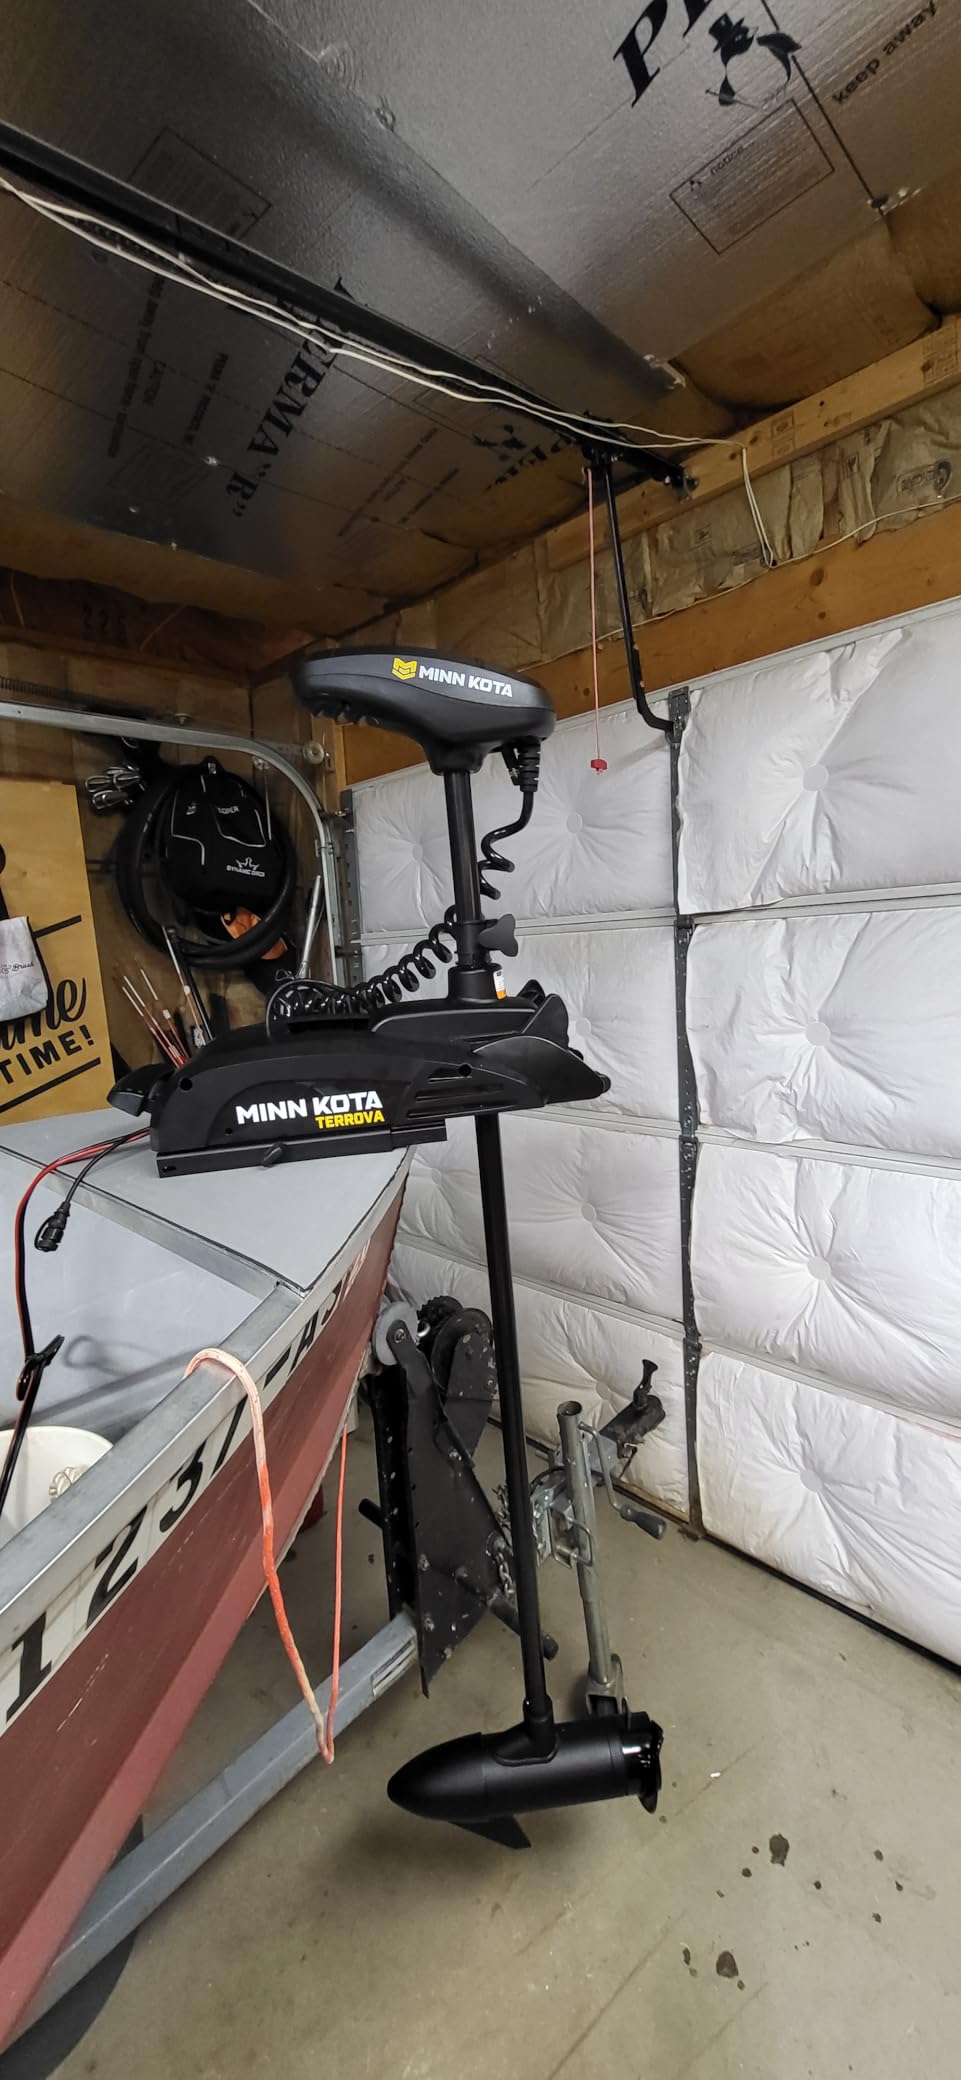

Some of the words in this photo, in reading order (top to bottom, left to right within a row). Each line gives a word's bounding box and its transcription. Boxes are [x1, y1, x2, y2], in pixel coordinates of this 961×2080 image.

[613, 0, 712, 107] P
[832, 58, 880, 105] keep
[883, 1, 937, 55] away
[248, 277, 355, 456] ERMA
[418, 665, 466, 687] MINN
[468, 675, 513, 698] KOTA
[0, 1024, 94, 1085] TIME!
[235, 1098, 308, 1125] MINN
[312, 1090, 384, 1116] KOTA
[315, 1109, 385, 1129] TERROVA
